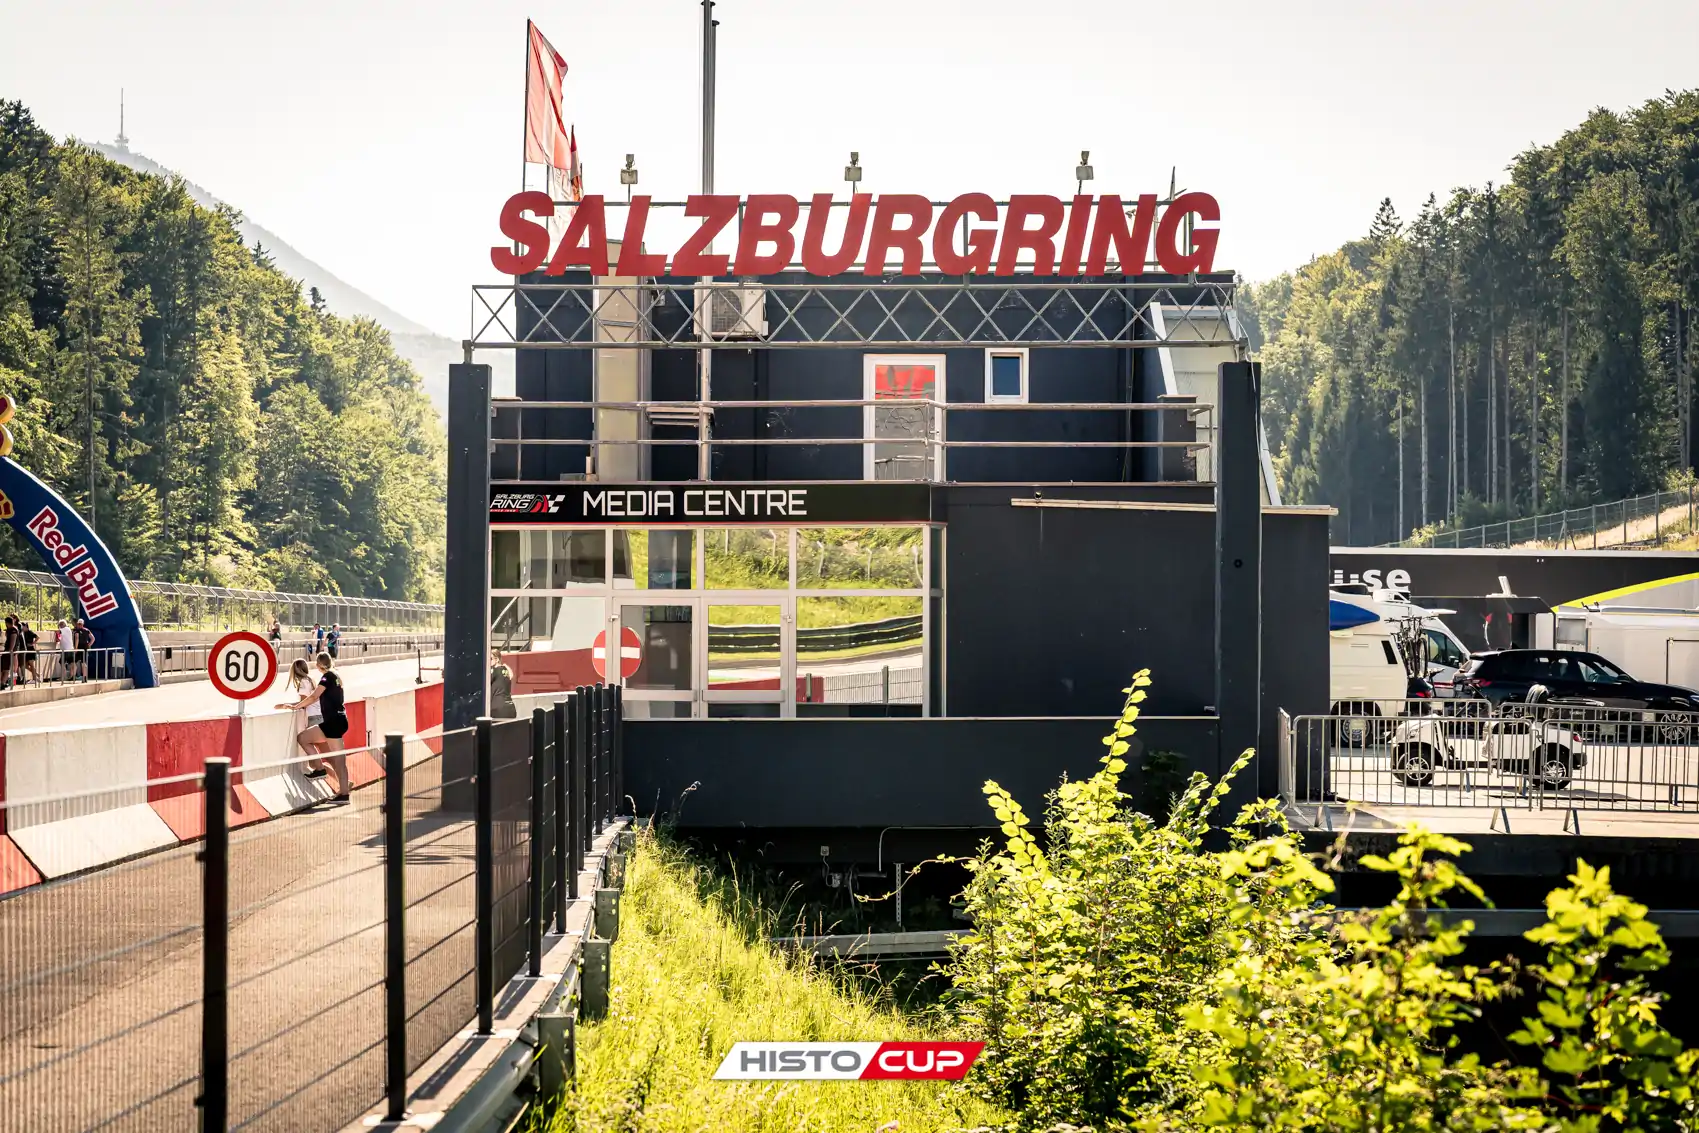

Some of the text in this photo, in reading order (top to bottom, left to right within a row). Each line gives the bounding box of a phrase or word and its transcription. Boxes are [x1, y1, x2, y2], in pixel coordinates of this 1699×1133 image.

[490, 192, 1221, 277] SALZBURGRING
[490, 499, 531, 509] RING
[583, 490, 807, 516] MEDIA CENTRE
[26, 505, 119, 620] Red Bull
[225, 650, 260, 682] 60
